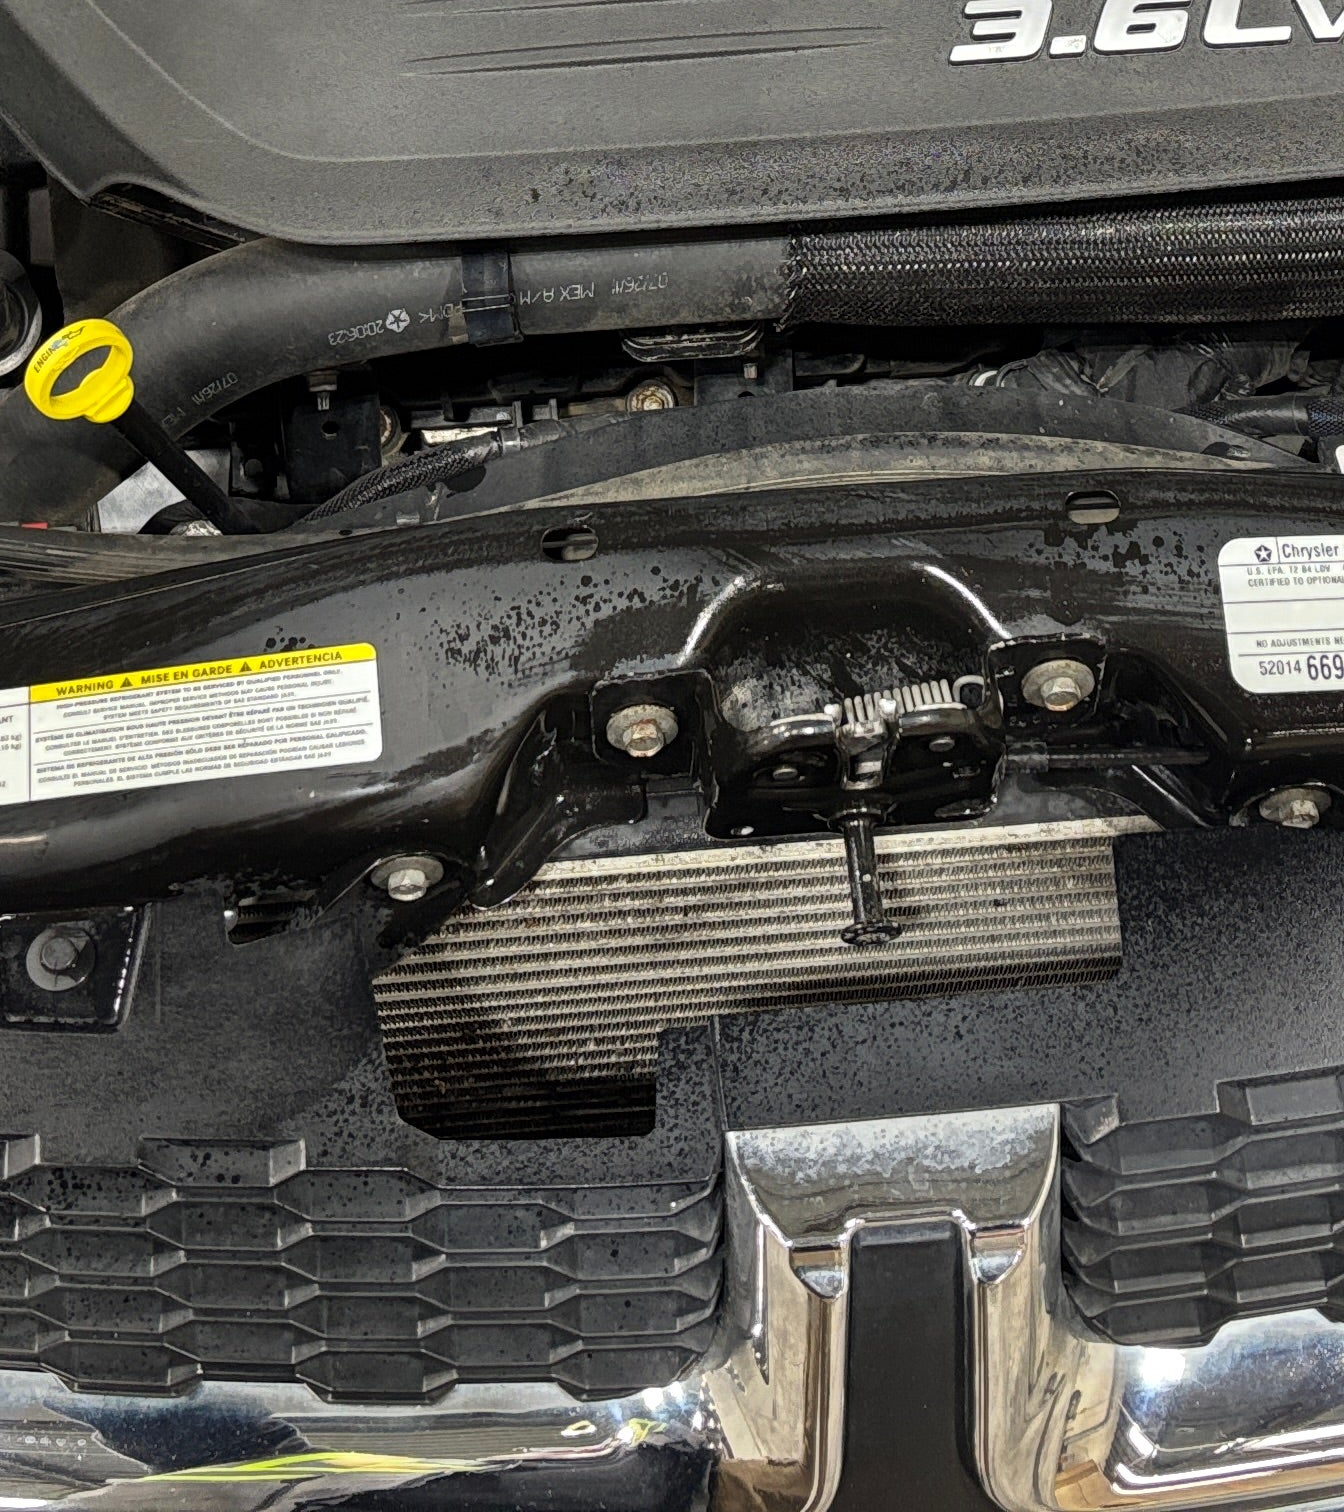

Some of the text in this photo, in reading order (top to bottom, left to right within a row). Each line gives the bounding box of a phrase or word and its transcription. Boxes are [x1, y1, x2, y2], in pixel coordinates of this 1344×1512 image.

[1282, 543, 1339, 560] Chrysler
[1271, 637, 1331, 648] ADJUSTMENTS
[259, 650, 342, 669] ADVERTENCIA
[141, 664, 232, 684] MISE EN GARDE
[1258, 660, 1302, 676] 52014
[56, 680, 113, 696] WARNING
